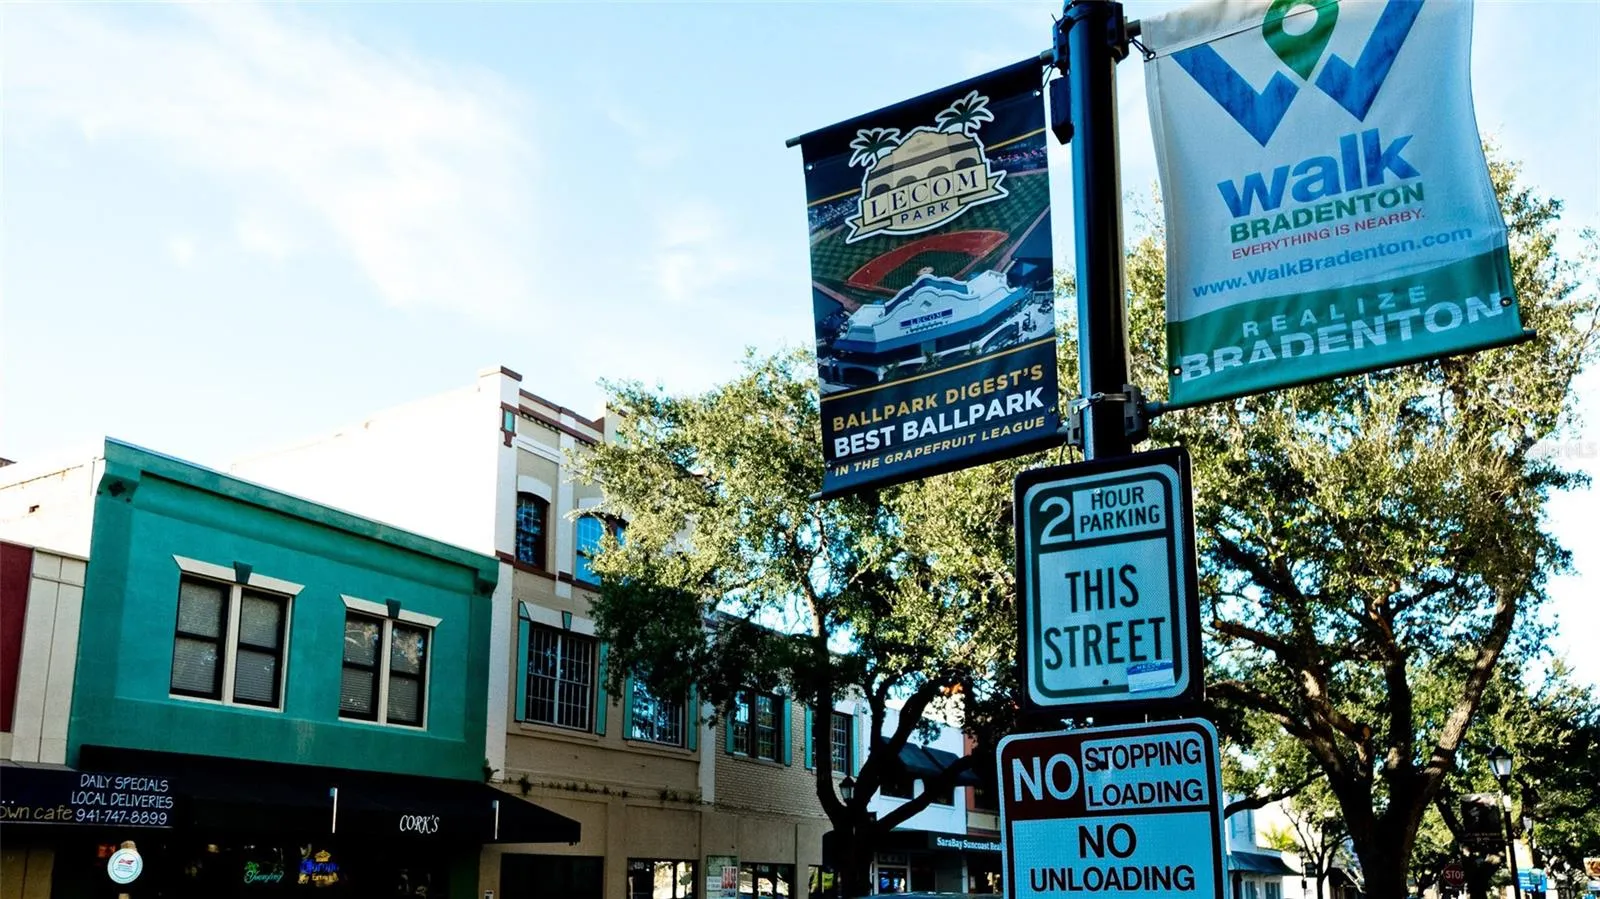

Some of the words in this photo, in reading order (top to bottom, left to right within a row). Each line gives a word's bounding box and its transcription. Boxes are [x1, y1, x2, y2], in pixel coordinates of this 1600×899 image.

[870, 169, 979, 219] LECOM
[1217, 127, 1422, 219] walk
[900, 202, 951, 224] PARK
[1230, 182, 1425, 244] BRADENTON
[1231, 227, 1331, 260] EVERYTHING
[1335, 223, 1350, 237] IS
[1354, 208, 1426, 233] NEARBY.
[1192, 228, 1473, 298] www.WalkBradenton.com
[1242, 285, 1428, 338] REALIZE
[1181, 292, 1506, 384] BRADENTON
[832, 393, 938, 432] BALLPARK
[945, 364, 1044, 405] DIGEST'S
[834, 425, 896, 458] BEST
[902, 386, 1045, 443] BALLPARK
[835, 465, 849, 477] IN
[853, 459, 880, 472] THE
[884, 433, 977, 465] GRAPEFRUIT
[981, 416, 1046, 441] LEAGUE
[1039, 496, 1073, 545] 2
[1091, 486, 1145, 510] HOUR
[1080, 504, 1160, 533] PARKING
[1065, 564, 1139, 613] THIS
[1043, 617, 1166, 671] STREET
[80, 774, 112, 789] DAILY
[114, 776, 169, 793] SPECIALS
[1012, 753, 1080, 802] NO
[1085, 739, 1201, 772] STOPPING
[1088, 778, 1204, 807] LOADING
[33, 804, 73, 821] cafe
[71, 791, 107, 806] LOCAL
[110, 793, 174, 808] DELIVERIES
[75, 810, 168, 825] 941-747-8899
[399, 814, 440, 834] CORK'S
[936, 836, 963, 850] SaraBay
[963, 840, 990, 850] Suncoast
[1078, 823, 1137, 859] NO
[1030, 864, 1196, 892] UNLOADING
